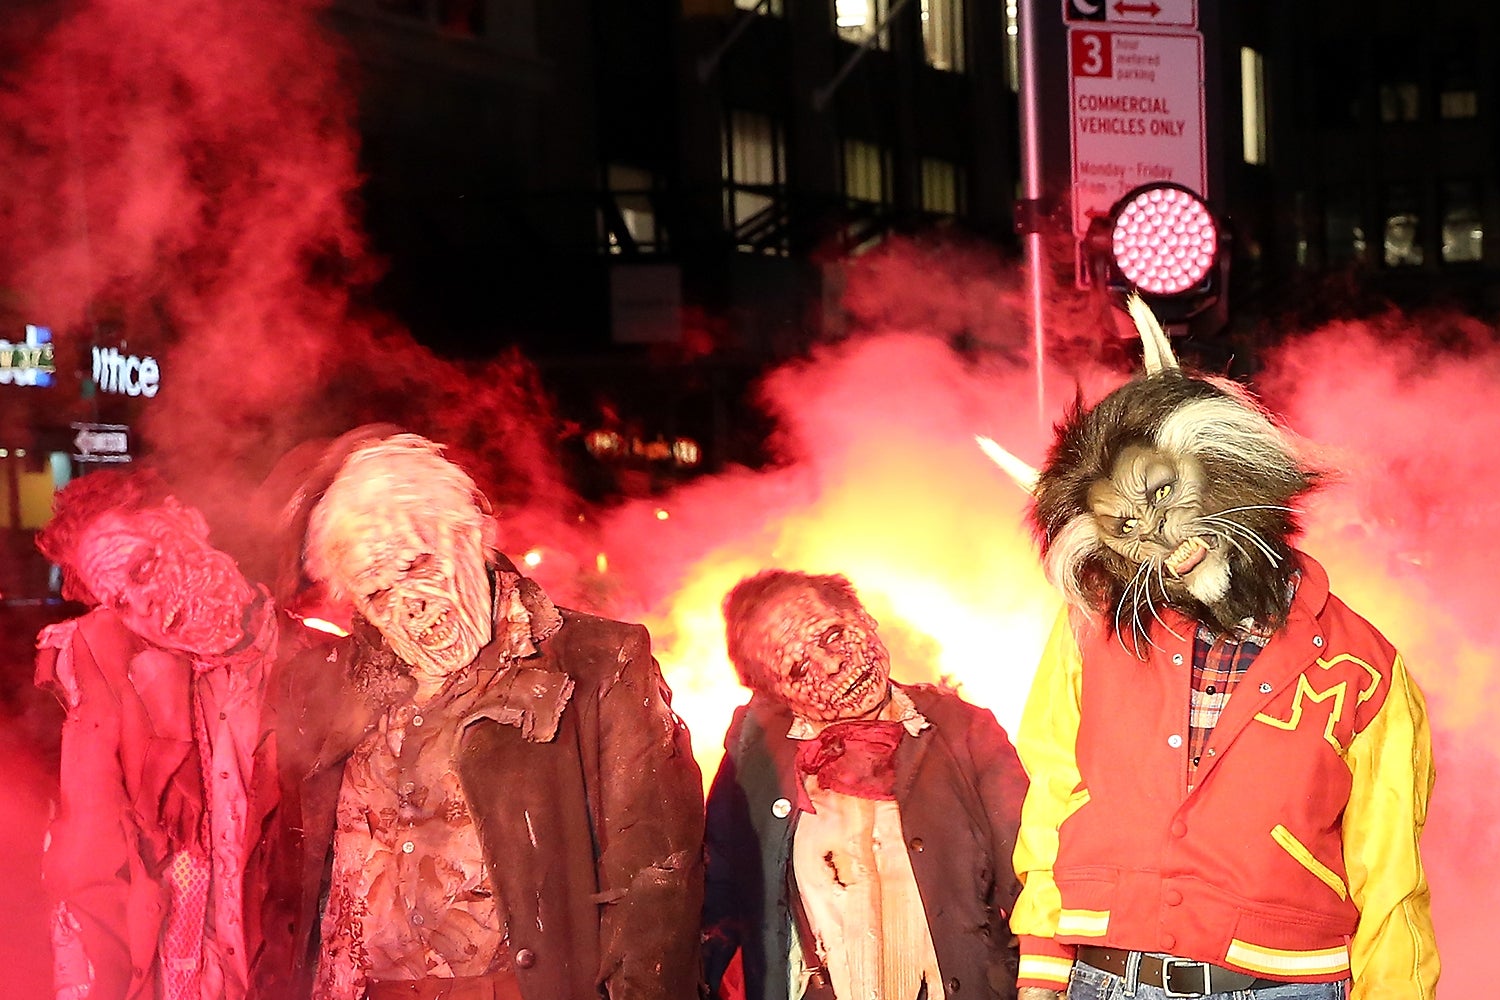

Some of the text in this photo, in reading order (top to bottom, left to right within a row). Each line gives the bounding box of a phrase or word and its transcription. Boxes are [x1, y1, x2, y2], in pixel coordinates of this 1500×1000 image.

[1081, 34, 1103, 75] 3
[1117, 53, 1160, 66] metered
[1117, 69, 1155, 82] parking
[1078, 95, 1170, 114] COMMERCIAL
[1079, 118, 1185, 136] VEHICLES ONLY
[1080, 161, 1125, 177] Monday
[1136, 162, 1173, 178] Friday
[1253, 653, 1382, 757] M
